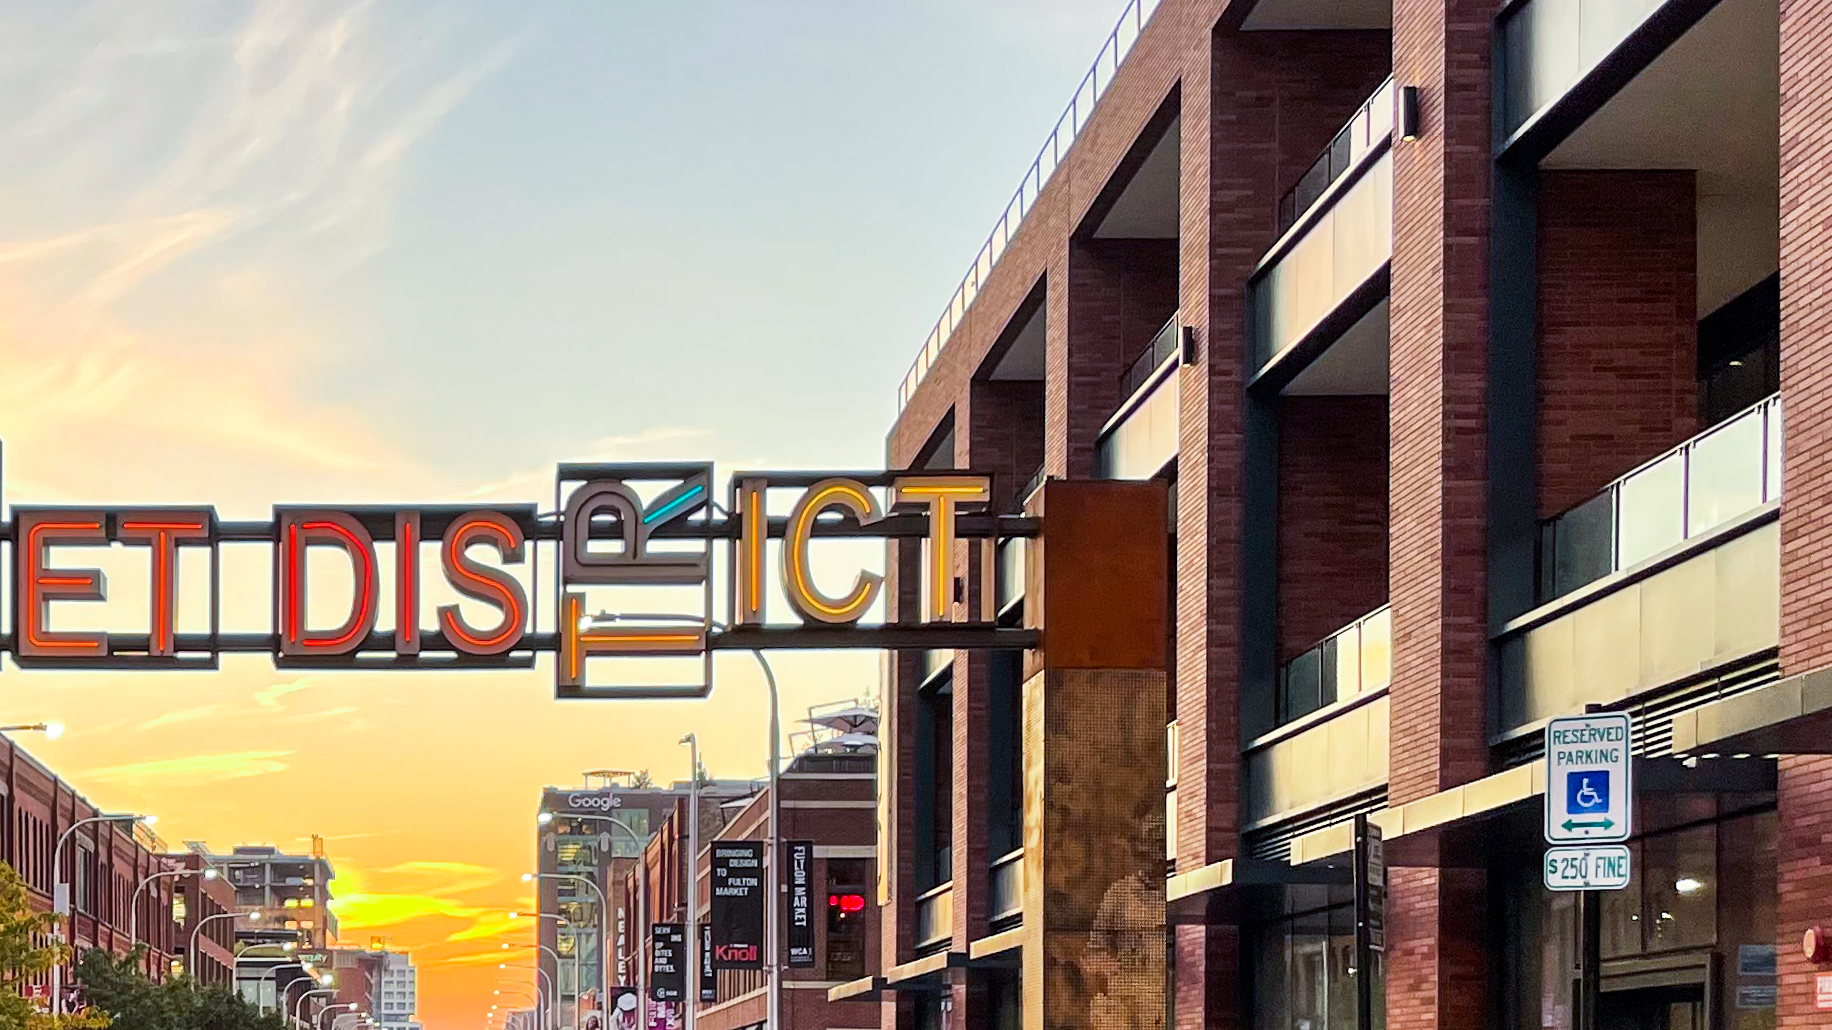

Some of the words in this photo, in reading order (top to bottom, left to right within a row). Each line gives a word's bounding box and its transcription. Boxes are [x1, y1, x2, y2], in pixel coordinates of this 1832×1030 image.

[1552, 726, 1624, 746] RESERVED
[1557, 748, 1619, 766] PARKING
[568, 794, 621, 811] Google
[715, 849, 754, 858] BRINGING
[729, 859, 758, 868] DESIGN
[793, 845, 806, 885] FULTON
[1595, 856, 1627, 878] FINE
[716, 868, 727, 877] TO
[727, 878, 758, 886] FULTON
[715, 887, 749, 896] MARKET
[793, 886, 808, 928] MARKET
[715, 945, 758, 961] Knoll
